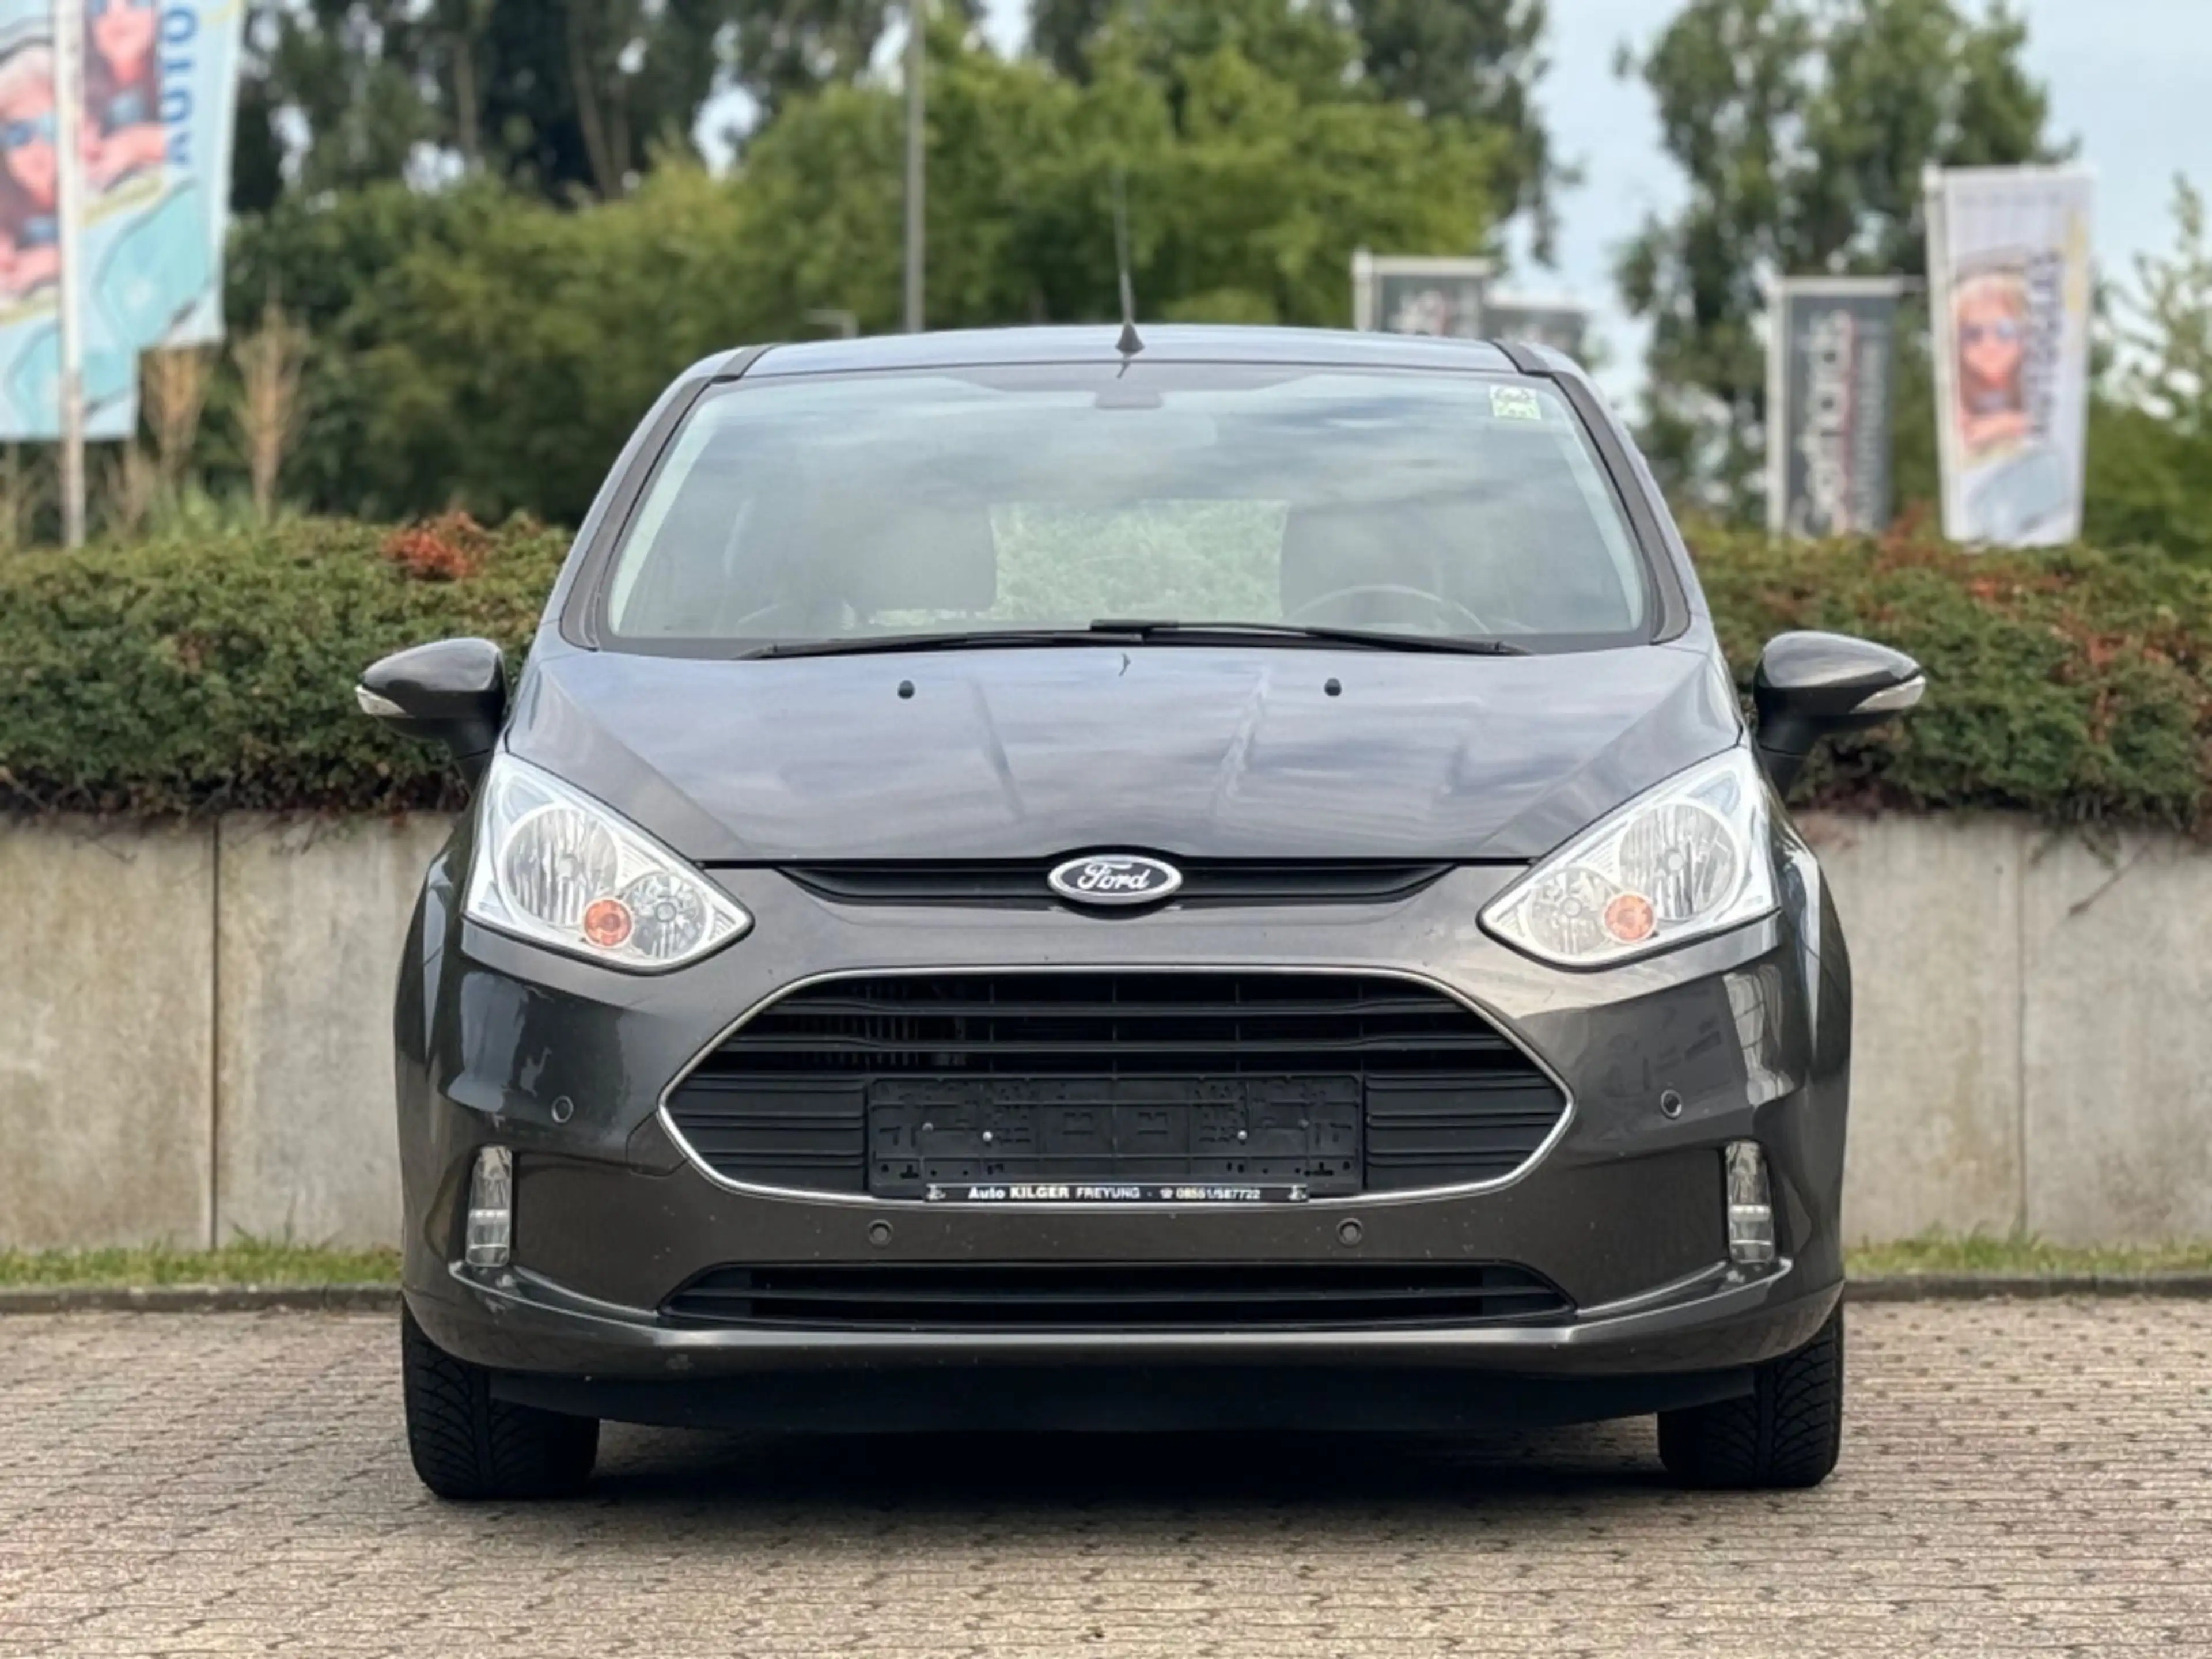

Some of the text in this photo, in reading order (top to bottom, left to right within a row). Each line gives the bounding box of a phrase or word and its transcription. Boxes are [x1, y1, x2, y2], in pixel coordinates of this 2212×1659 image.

[161, 7, 199, 166] AUTO
[1077, 862, 1150, 889] Ford
[968, 1186, 1006, 1199] Auto
[1010, 1186, 1070, 1199] KILGER
[1075, 1187, 1141, 1199] FREYUNG
